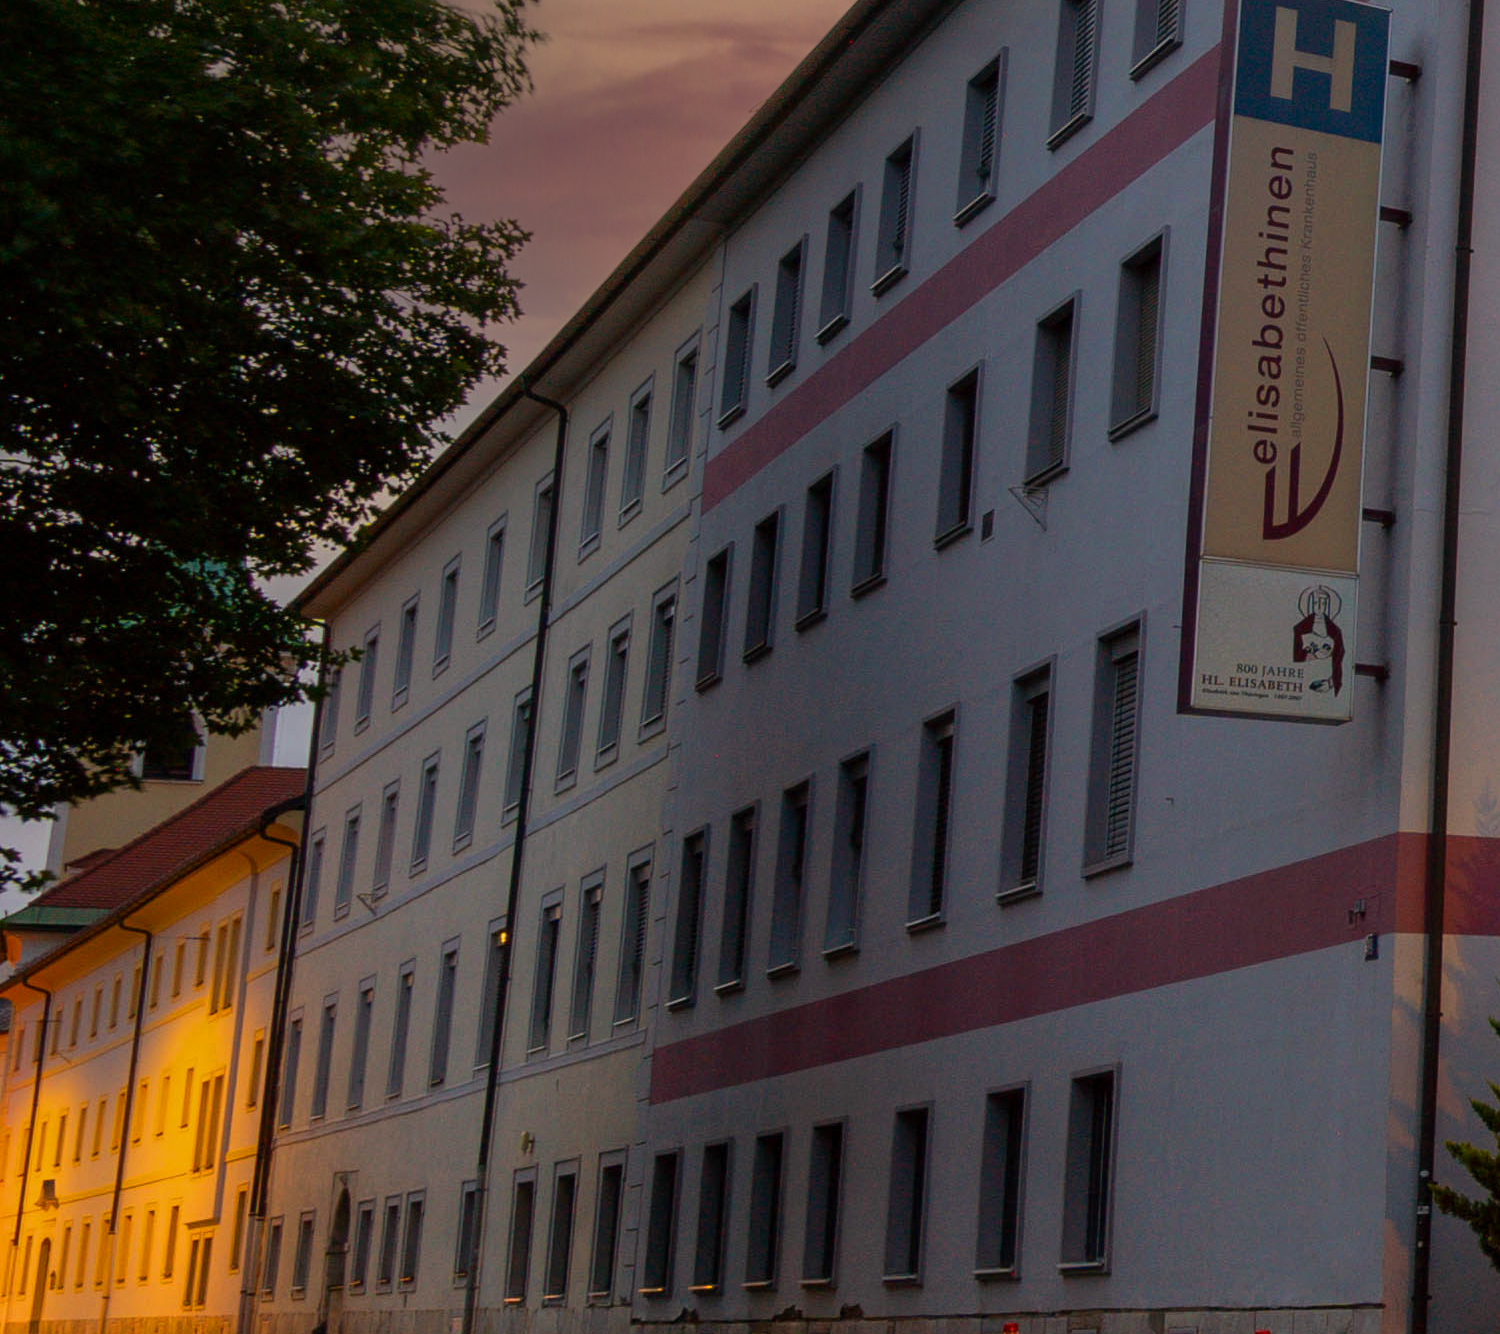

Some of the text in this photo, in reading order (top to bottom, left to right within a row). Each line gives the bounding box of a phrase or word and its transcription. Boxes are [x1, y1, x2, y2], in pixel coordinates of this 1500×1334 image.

[1270, 6, 1356, 113] H
[1247, 146, 1295, 465] elisabethinen
[1290, 152, 1319, 438] allgemeines öffentliches Krankenhaus
[1201, 674, 1303, 693] HL. ELISABETH
[1236, 663, 1305, 679] 800 JAHRE
